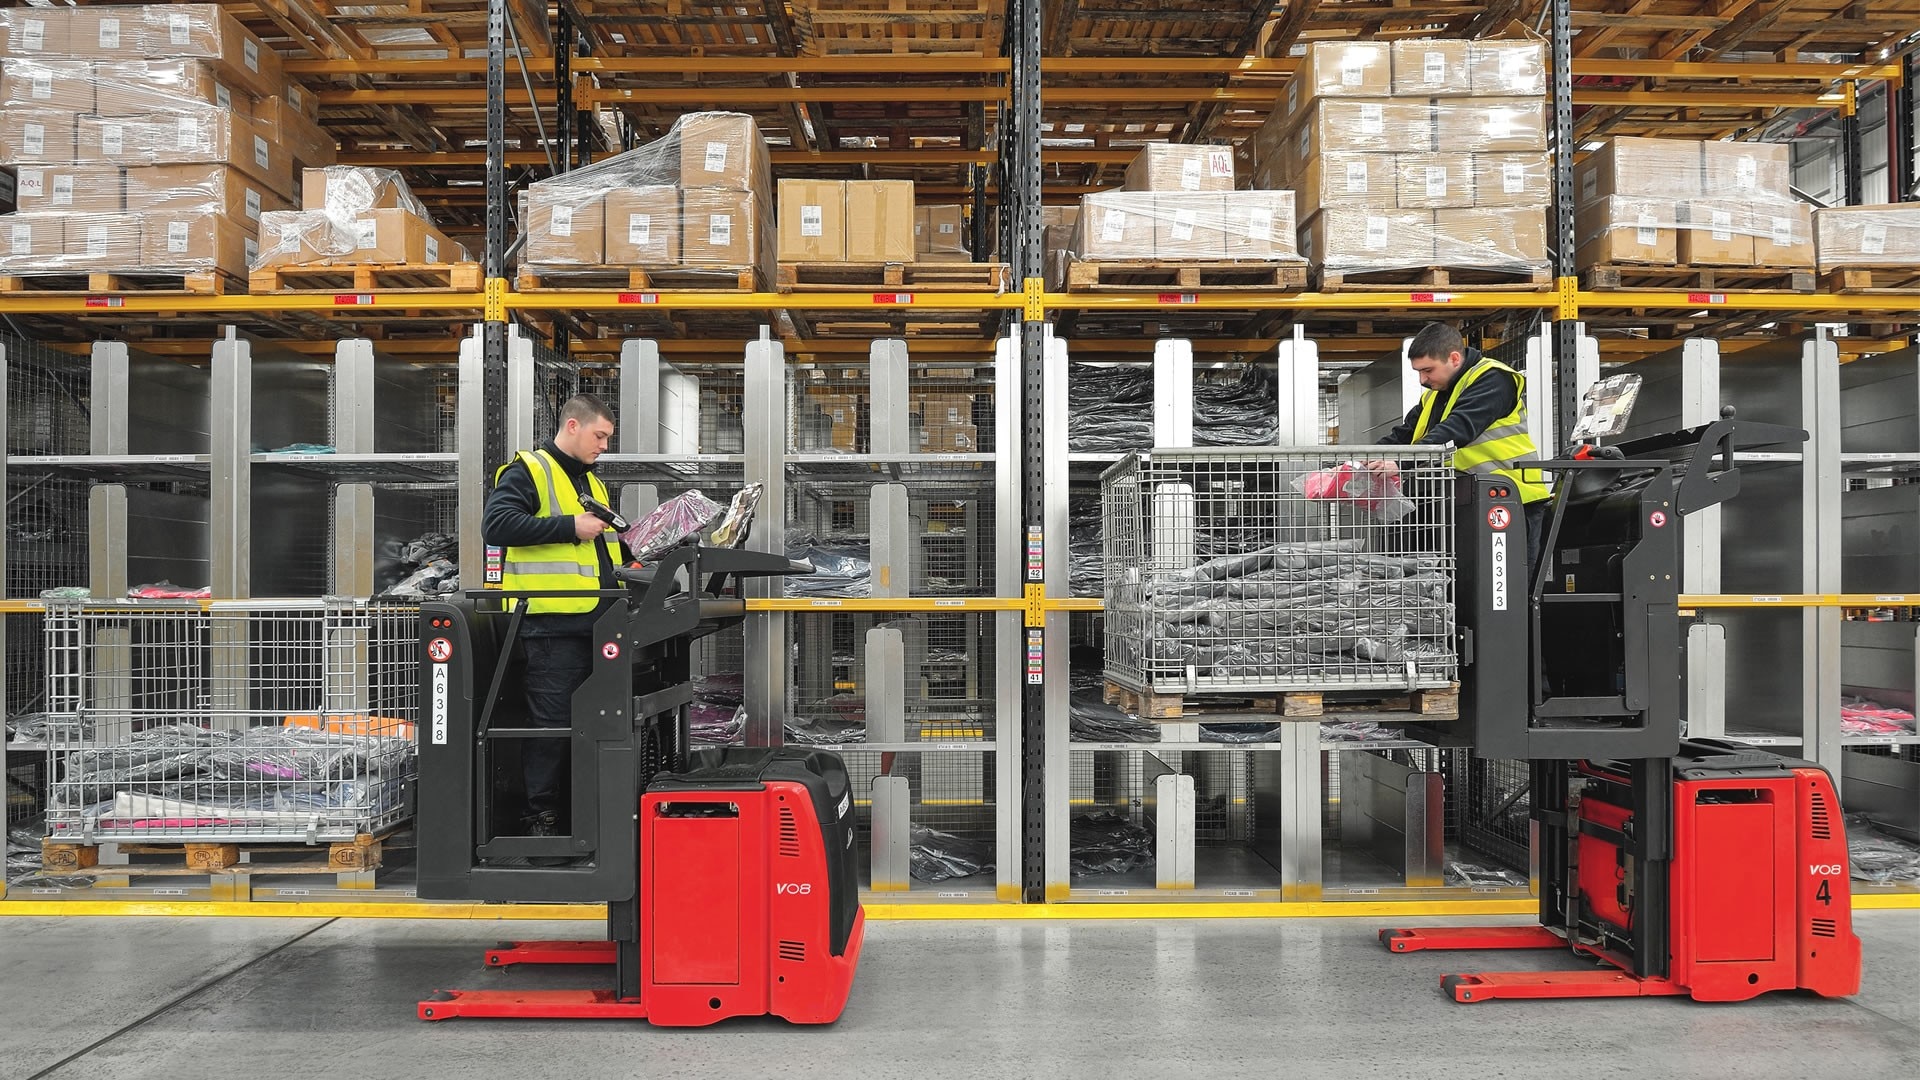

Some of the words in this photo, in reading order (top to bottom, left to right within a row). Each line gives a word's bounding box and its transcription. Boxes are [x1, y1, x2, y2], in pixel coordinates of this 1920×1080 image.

[1030, 569, 1041, 577] 42
[1494, 536, 1504, 607] A6323
[435, 667, 445, 741] A6328
[1815, 879, 1832, 906] 4
